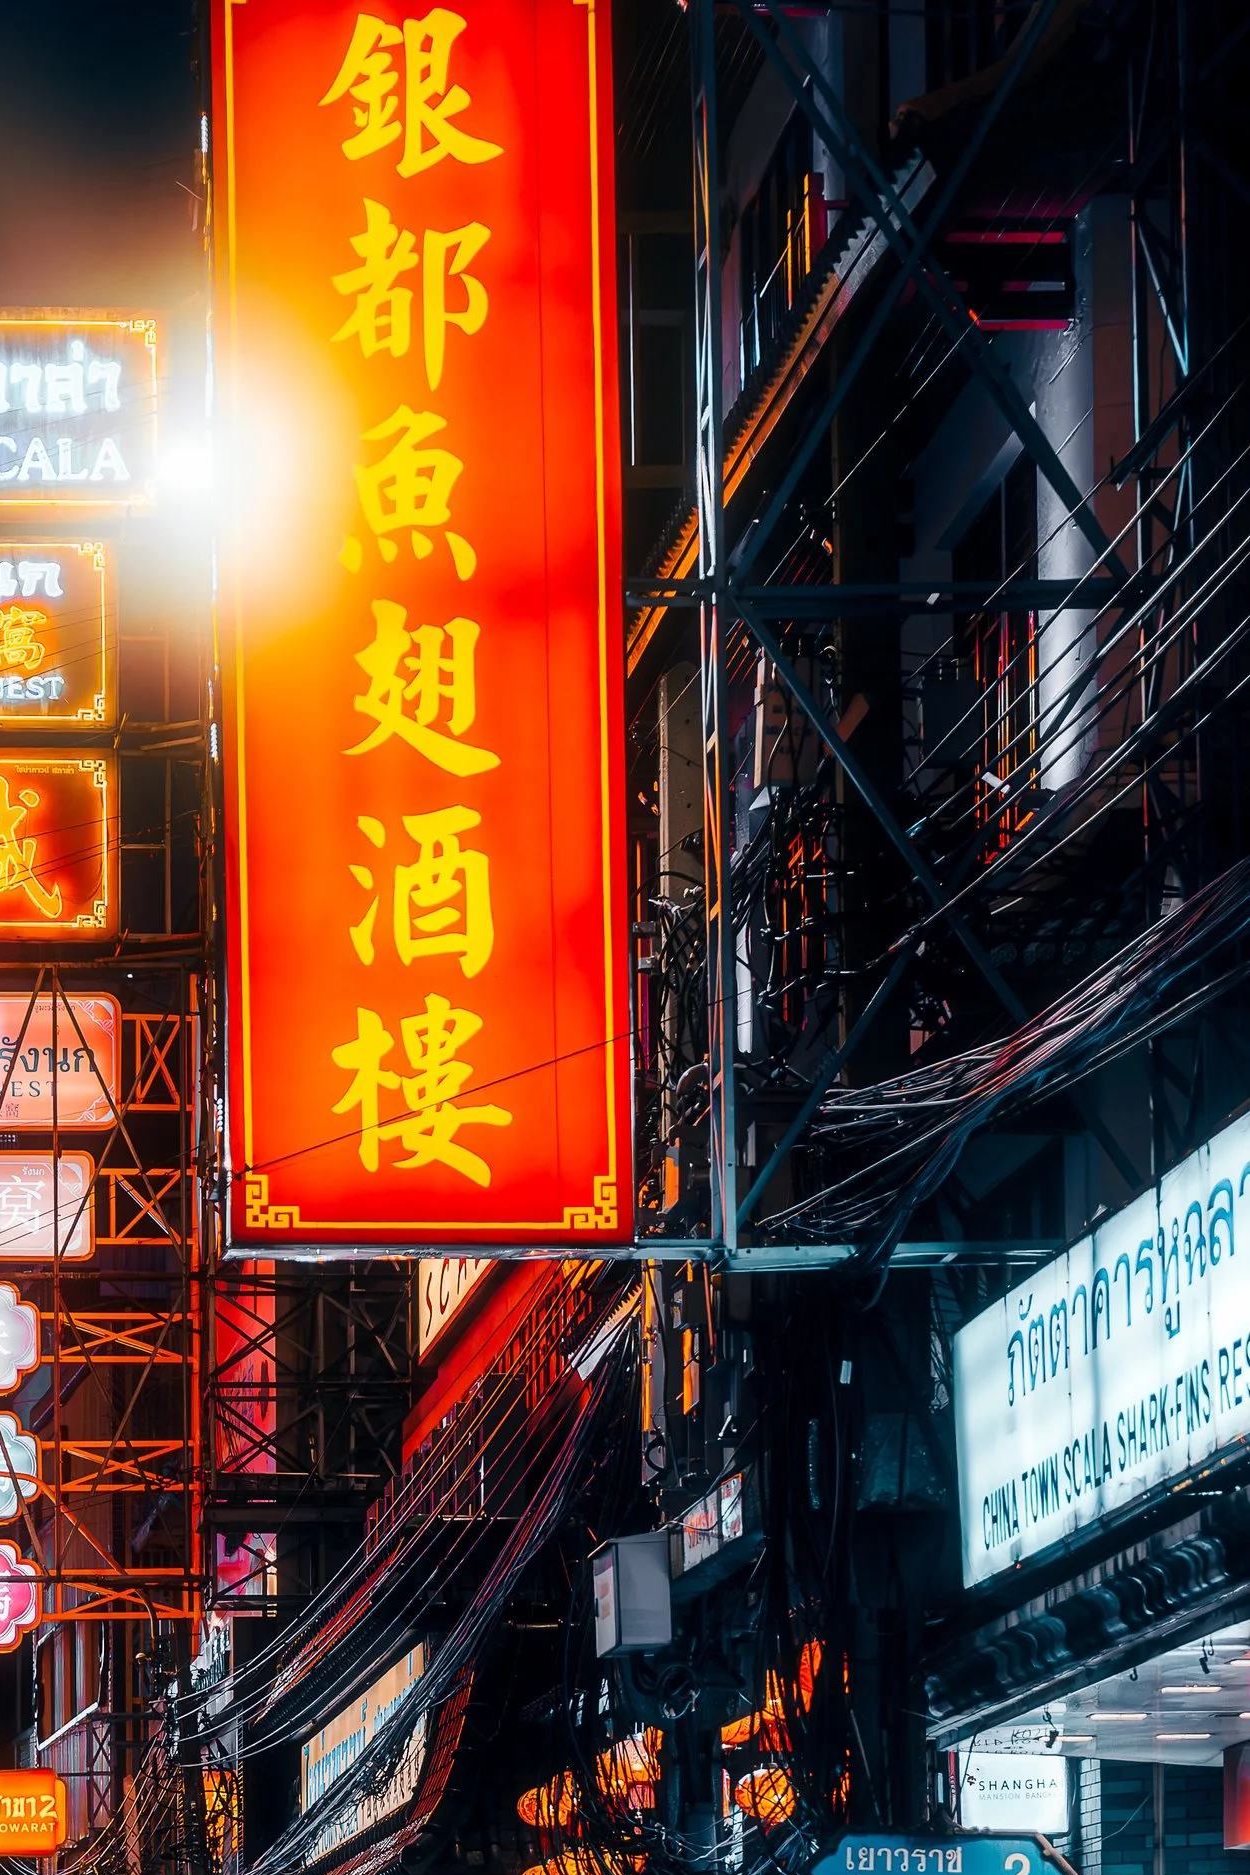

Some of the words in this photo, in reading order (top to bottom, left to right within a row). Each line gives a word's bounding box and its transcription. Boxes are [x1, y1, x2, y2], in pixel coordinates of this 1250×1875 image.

[317, 6, 515, 1190] 銀都魚翅酒樓
[982, 1478, 1021, 1552] CHINA
[1022, 1450, 1061, 1530] TOWN
[1064, 1420, 1113, 1505] SCALA
[1117, 1357, 1212, 1474] SHARK-FINS
[978, 1778, 1064, 1792] SHANGHA
[845, 1846, 963, 1875] เยาวราช
